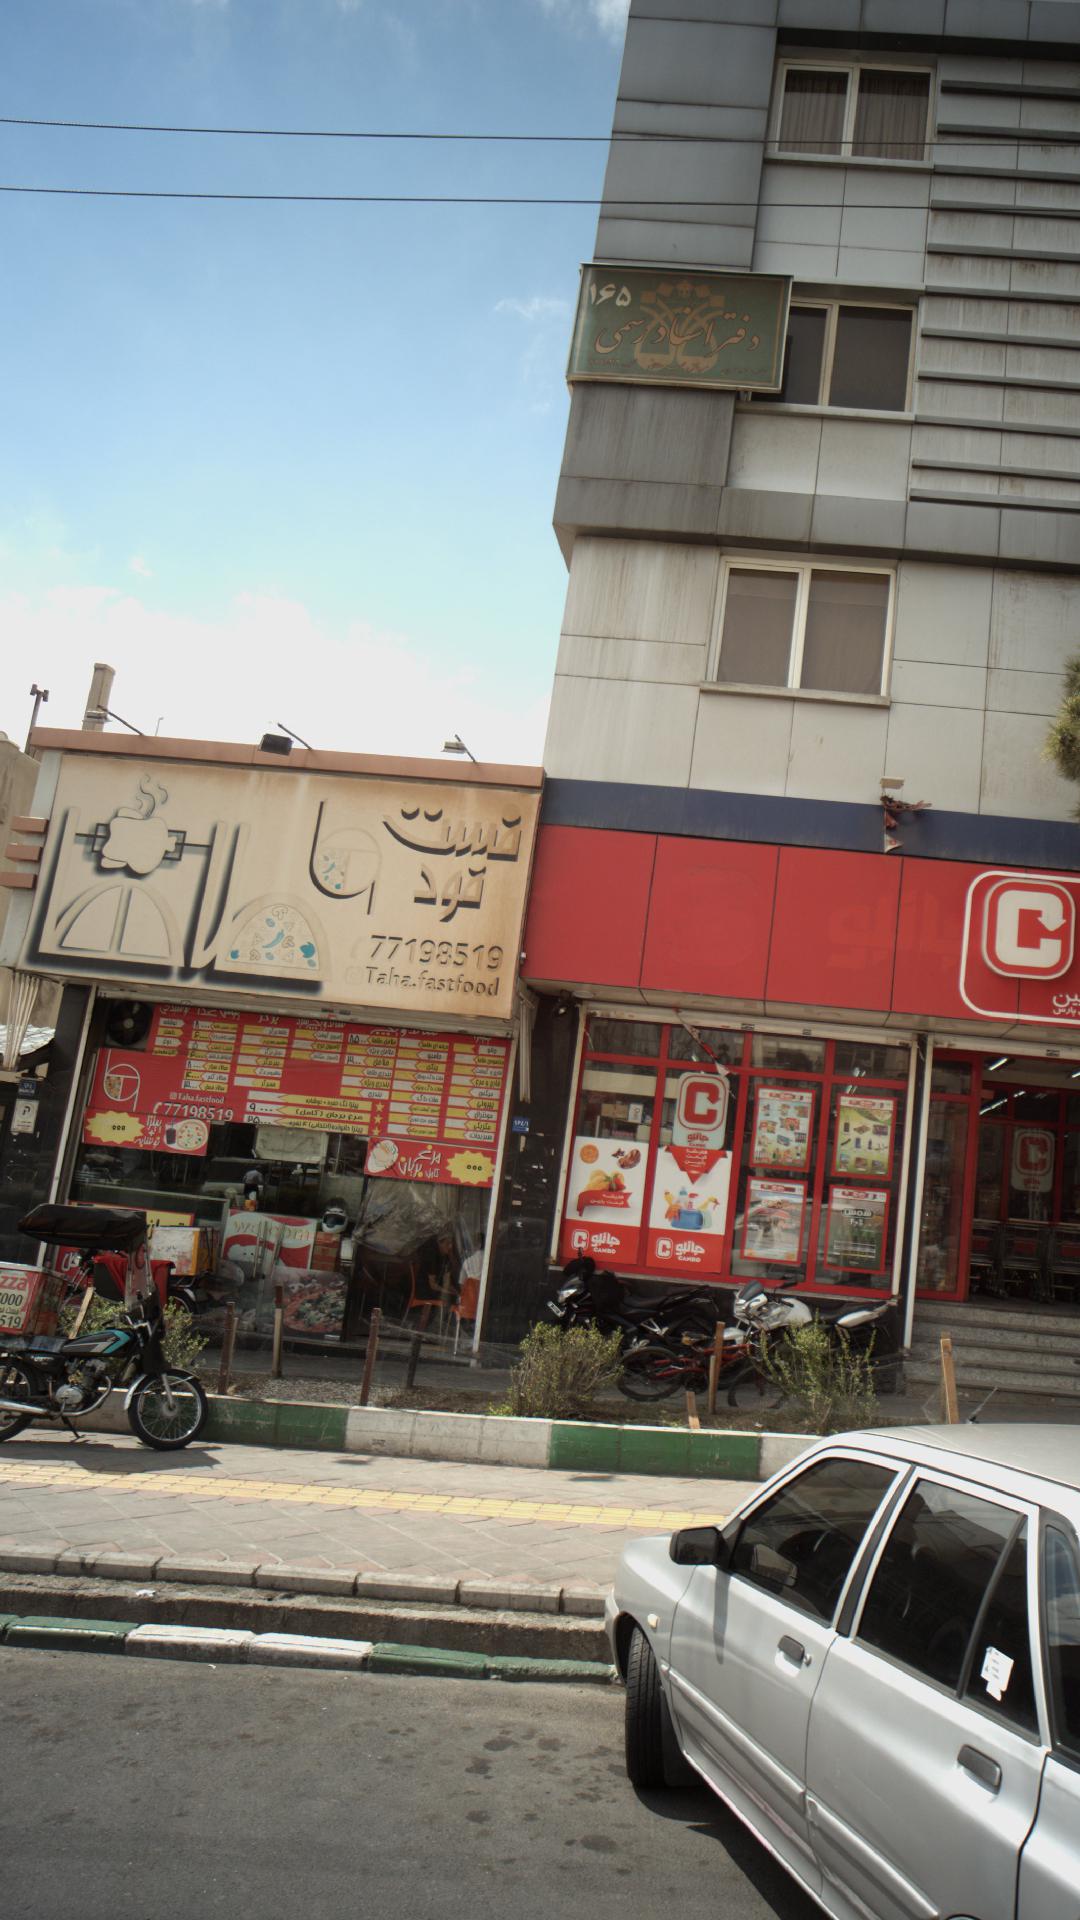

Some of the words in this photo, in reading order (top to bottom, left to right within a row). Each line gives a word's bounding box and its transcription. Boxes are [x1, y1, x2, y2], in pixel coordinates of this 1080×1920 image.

[590, 282, 632, 307] ۱۶۵
[383, 804, 523, 862] فست
[412, 863, 487, 922] فود
[368, 934, 504, 971] 77198519
[365, 965, 500, 997] Taha.fastfood
[165, 1103, 234, 1122] 77198519
